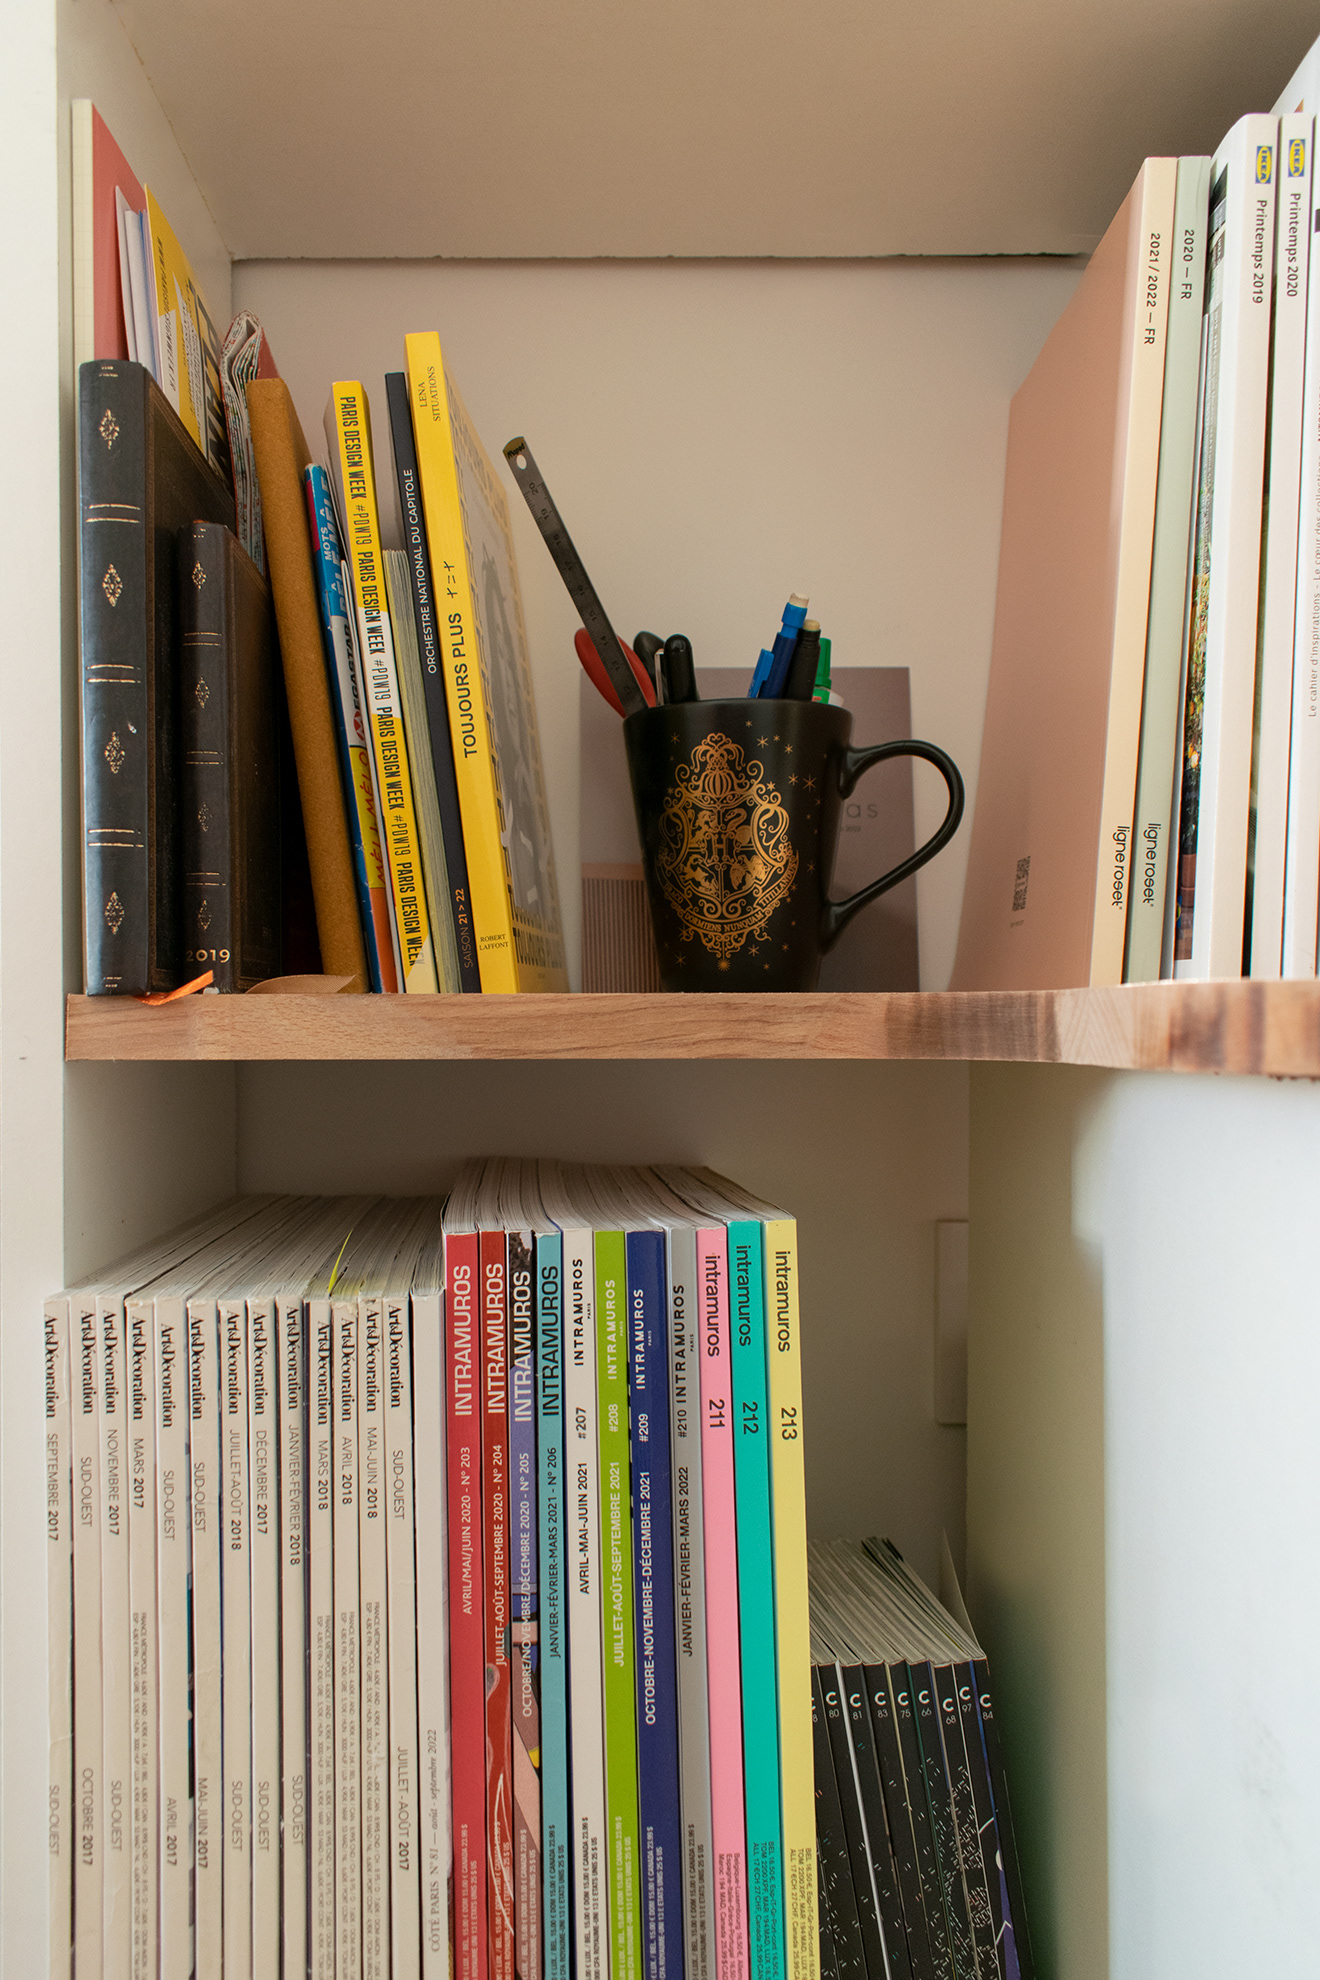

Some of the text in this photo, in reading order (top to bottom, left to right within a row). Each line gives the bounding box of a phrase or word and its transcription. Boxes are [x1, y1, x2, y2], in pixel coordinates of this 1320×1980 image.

[1180, 229, 1194, 299] 2020 FR
[1252, 200, 1267, 304] Printemps 2019
[1285, 193, 1301, 297] Printemps 2020
[1144, 328, 1155, 345] FR
[340, 396, 357, 427] PARIS
[418, 366, 441, 422] LENA SITUATIONS
[344, 430, 363, 467] DESIGN
[348, 470, 367, 499] WEEK
[528, 482, 538, 495] 20
[541, 508, 550, 521] 19
[320, 527, 332, 560] MOTS
[357, 551, 376, 582] PARIS
[403, 469, 437, 674] ORCHESTRE NATIONAL DU CAPITOLE
[361, 585, 381, 623] DESIGN
[365, 625, 385, 654] WEEK
[448, 613, 478, 758] TOUJOURS PLUS
[1308, 669, 1318, 702] cahier
[376, 706, 396, 738] PARIS
[1308, 705, 1317, 717] Le
[380, 741, 401, 778] DESIGN
[385, 782, 404, 810] WEEK
[1112, 825, 1130, 862] ligne
[1143, 823, 1161, 860] ligne
[396, 861, 416, 893] PARIS
[663, 882, 684, 905] DRACO
[758, 860, 797, 907] TITILLANDUS
[400, 896, 421, 934] DESIGN
[455, 888, 473, 968] SAISON 21 22
[684, 910, 763, 932] DORMIENS NUNQUAM
[186, 949, 230, 963] 2019
[479, 934, 509, 951] ROBERT LAFFONT
[572, 1258, 584, 1366] INTRAMUROS
[706, 1255, 720, 1357] intramuros
[736, 1245, 752, 1346] intramuros
[775, 1251, 791, 1352] intramuros
[454, 1265, 472, 1416] INTRAMUROS
[486, 1263, 505, 1414] INTRAMUROS
[513, 1271, 531, 1422] INTRAMUROS
[542, 1266, 559, 1416] INTRAMUROS
[605, 1279, 617, 1379] INTRAMUROS
[633, 1289, 645, 1390] INTRAMUROS
[673, 1285, 686, 1404] INTRAMUROS
[576, 1407, 587, 1440] #207
[608, 1404, 619, 1432] #208
[639, 1413, 649, 1442] #209
[677, 1410, 687, 1438] #210
[709, 1398, 725, 1428] 211
[742, 1401, 758, 1434] 212
[781, 1407, 797, 1440] 213
[47, 1433, 58, 1541] SEPTEMBRE 2017
[81, 1456, 92, 1527] SUD-OUEST
[108, 1429, 119, 1535] NOVEMBRE 2017
[133, 1438, 144, 1508] MARS 2017
[230, 1429, 242, 1550] JUILLET-AOÛT 2018
[256, 1430, 268, 1534] DÉCEMBRE 2017
[366, 1427, 377, 1518] MAI-JUIN 2018
[392, 1450, 405, 1520] SUD-OUEST
[163, 1470, 175, 1541] SUD-OUEST
[194, 1462, 206, 1532] SUD-OUEST
[288, 1425, 301, 1566] JANVIER-FÉVRIER 2018
[460, 1447, 473, 1614] AVRIL/MAI/JUIN 2020 203
[577, 1462, 590, 1595] AVRIL-MAI-JUIN 2021
[492, 1445, 507, 1666] JUILLET-AOÛT-SEPTEMBRE 2020 204
[546, 1447, 561, 1658] JANVIER-FÉVRIER-MARS 2021 206
[609, 1462, 625, 1667] JUILLET-AOÛT-SEPTEMBRE 2021
[678, 1467, 693, 1657] JANVIER-FÉVRIER-MARS 2022
[519, 1453, 533, 1716] OCTOBRE/NOVEMBRE/DÉCEMBRE 2020 205
[639, 1471, 656, 1725] OCTOBRE-NOVEMBRE-DÉCEMBRE 2021
[826, 1692, 838, 1706] C
[829, 1709, 839, 1718] 80
[850, 1693, 861, 1707] C
[853, 1711, 862, 1720] 81
[898, 1692, 909, 1706] C
[900, 1710, 911, 1719] 75
[980, 1694, 992, 1708] C
[982, 1711, 994, 1720] 84
[427, 1729, 437, 1754] 2022
[428, 1757, 438, 1800] septembre
[83, 1768, 93, 1865] OCTOBRE 2017
[167, 1797, 177, 1866] AVRIL 2017
[198, 1777, 208, 1868] MAI-JUIN 2017
[430, 1881, 440, 1915] PARIS
[428, 1919, 441, 1953] CÔTÉ
